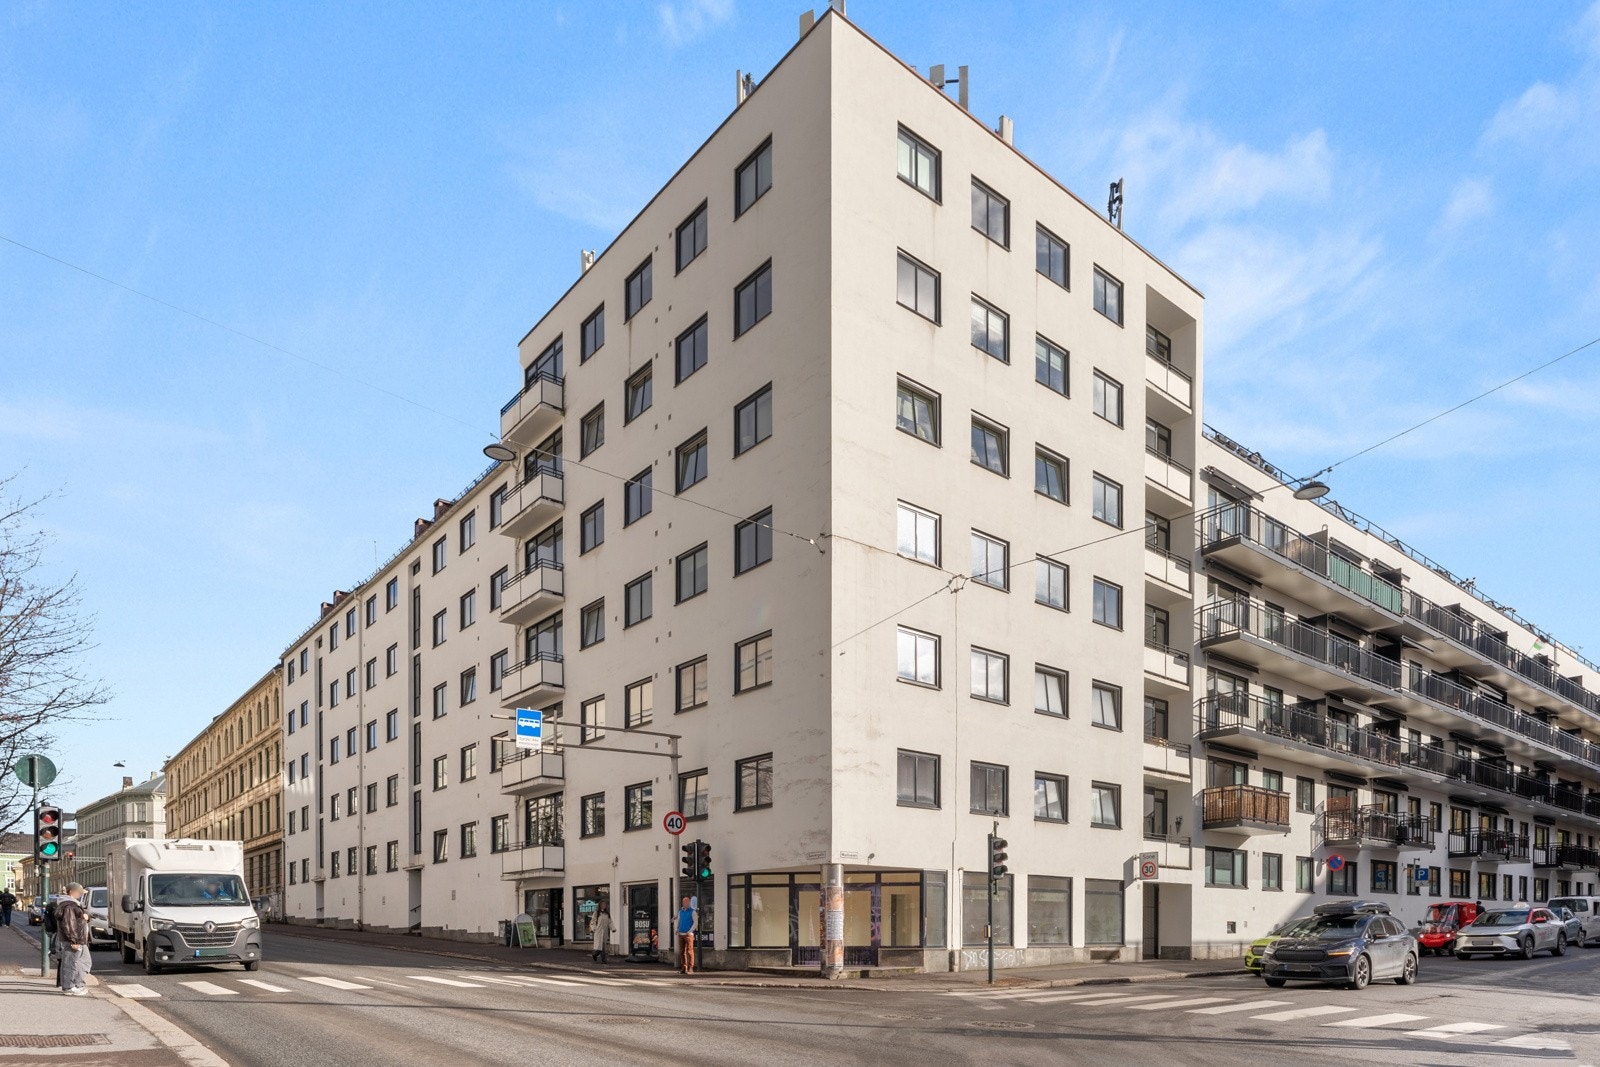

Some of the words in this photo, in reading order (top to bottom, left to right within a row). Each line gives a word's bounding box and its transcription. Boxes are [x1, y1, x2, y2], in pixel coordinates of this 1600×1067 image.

[668, 817, 682, 829] 40
[1144, 865, 1154, 874] 30
[1417, 870, 1425, 879] P
[634, 920, 650, 928] BOSU
